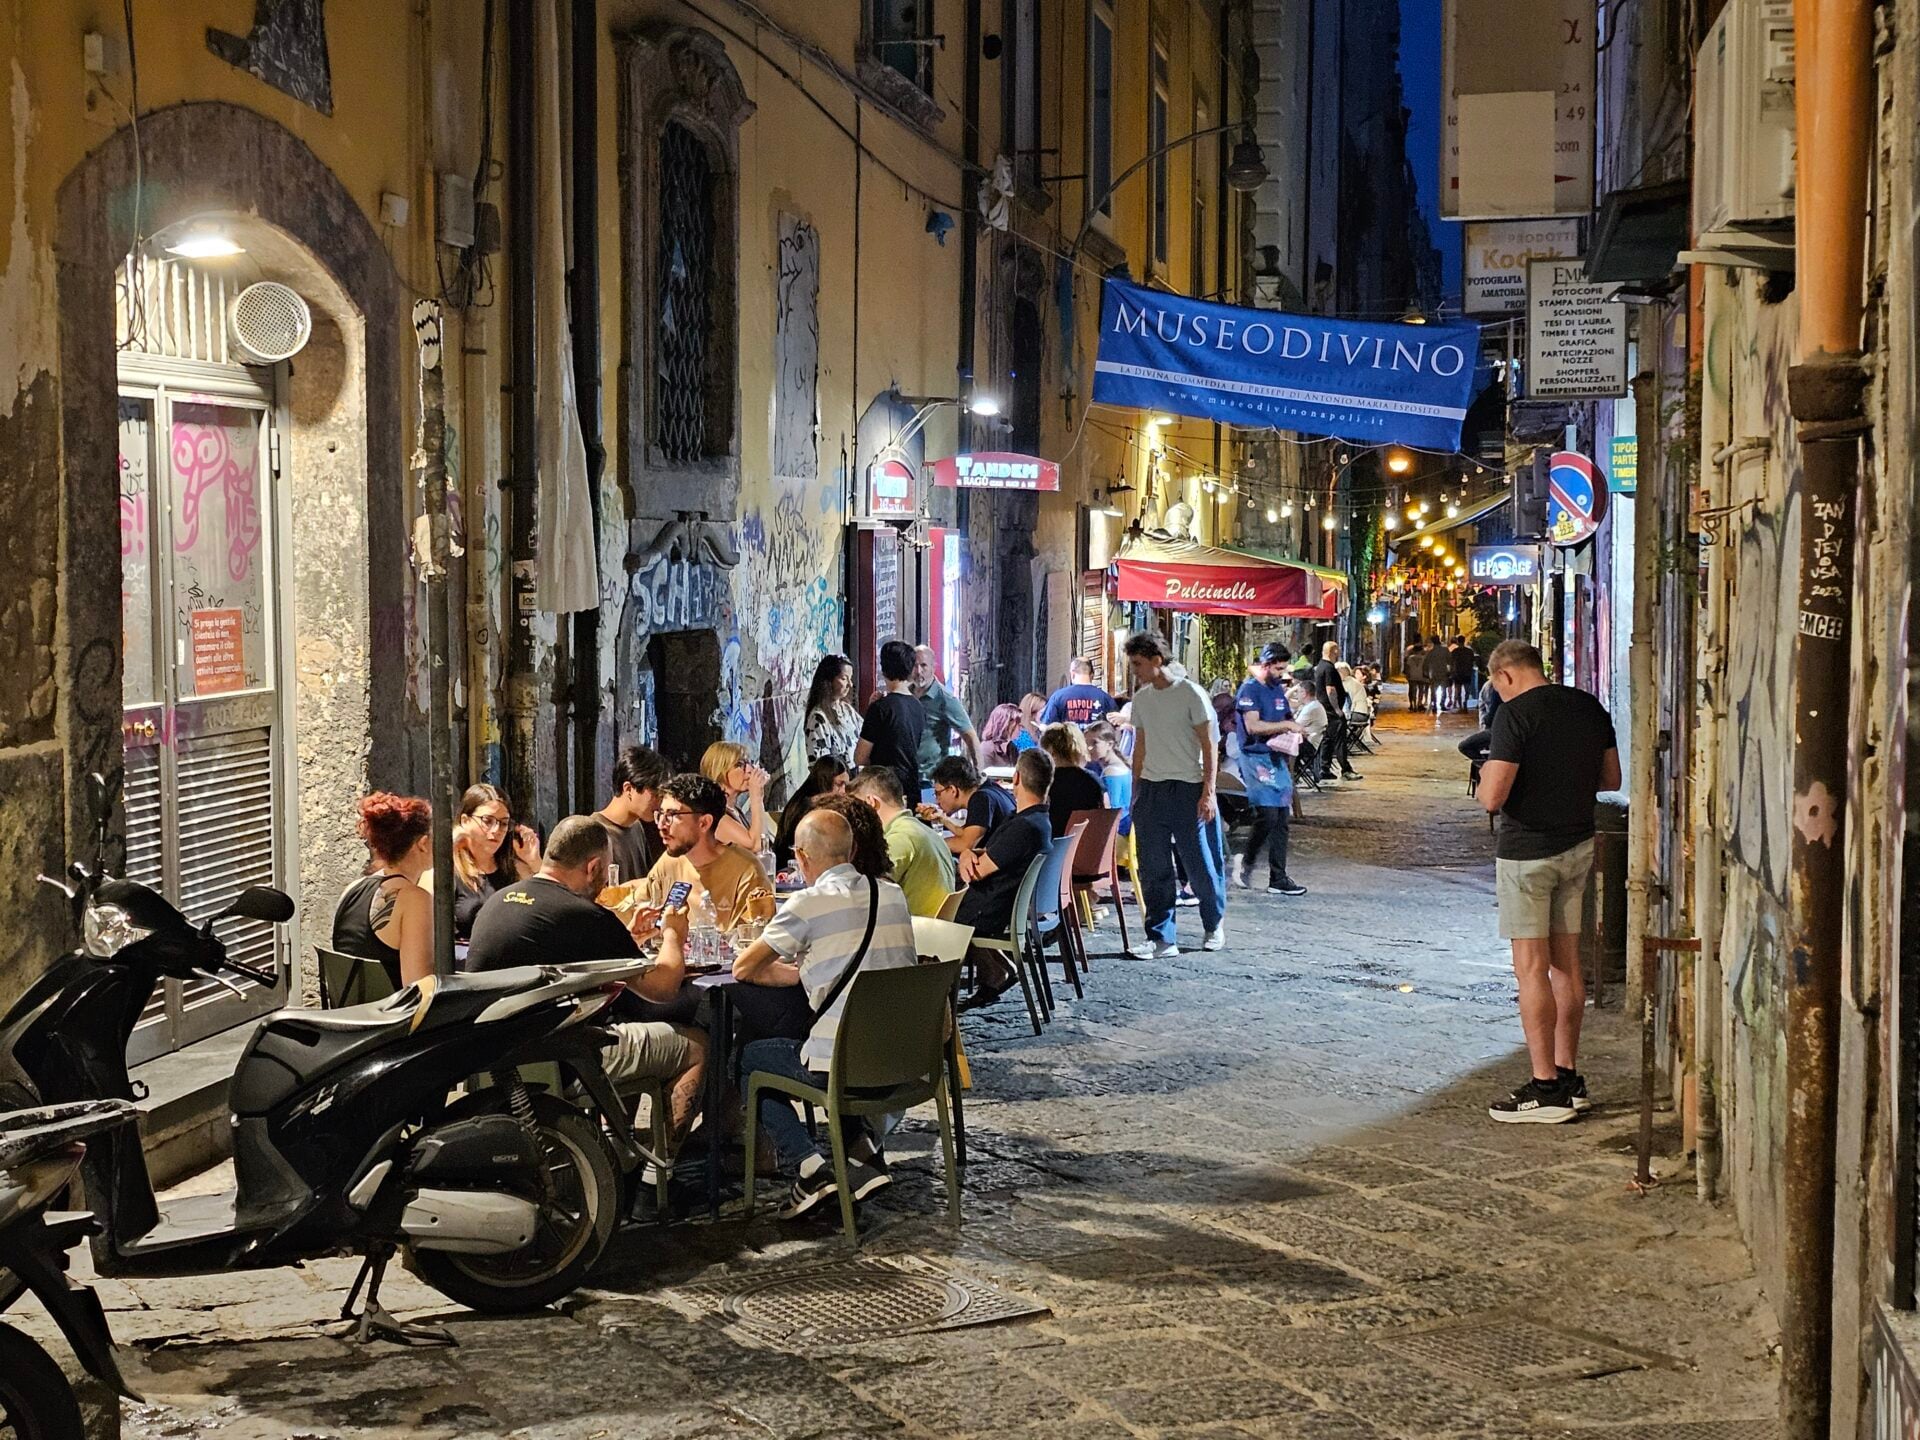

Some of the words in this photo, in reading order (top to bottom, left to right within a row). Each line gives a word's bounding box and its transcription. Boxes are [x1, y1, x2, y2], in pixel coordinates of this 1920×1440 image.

[1468, 275, 1522, 286] FOTOGRAFIA
[1552, 287, 1603, 296] FOTOCOPIE
[1539, 299, 1573, 308] STAMPA
[1553, 308, 1602, 316] SCANSIONI
[1578, 318, 1612, 326] LAUREA
[1581, 327, 1615, 336] TARGHE
[1112, 302, 1465, 377] MUSEODIVINO
[1558, 339, 1597, 347] GRAFICA
[1541, 348, 1615, 357] PARTECIPAZIONI
[1562, 356, 1594, 364] NOZZE
[1556, 368, 1600, 376] SHOPPERS
[1540, 375, 1616, 385] PERSONALIZZATE
[1120, 366, 1131, 374] LA
[1135, 367, 1170, 381] DIVINA
[1173, 374, 1227, 390] COMMEDIA
[1248, 386, 1286, 397] PRESEPI
[1304, 393, 1353, 404] ANTONIO
[1357, 399, 1389, 409] MARIA
[1393, 403, 1441, 415] ESPOSITO
[1536, 384, 1621, 395] EMMEPRINTNAPOLI.IT
[955, 456, 1039, 479] TANDEM
[1810, 565, 1842, 580] USA
[1165, 578, 1257, 600] Pulcinella
[1811, 585, 1842, 597] 2023
[1066, 699, 1093, 710] NAPOLI
